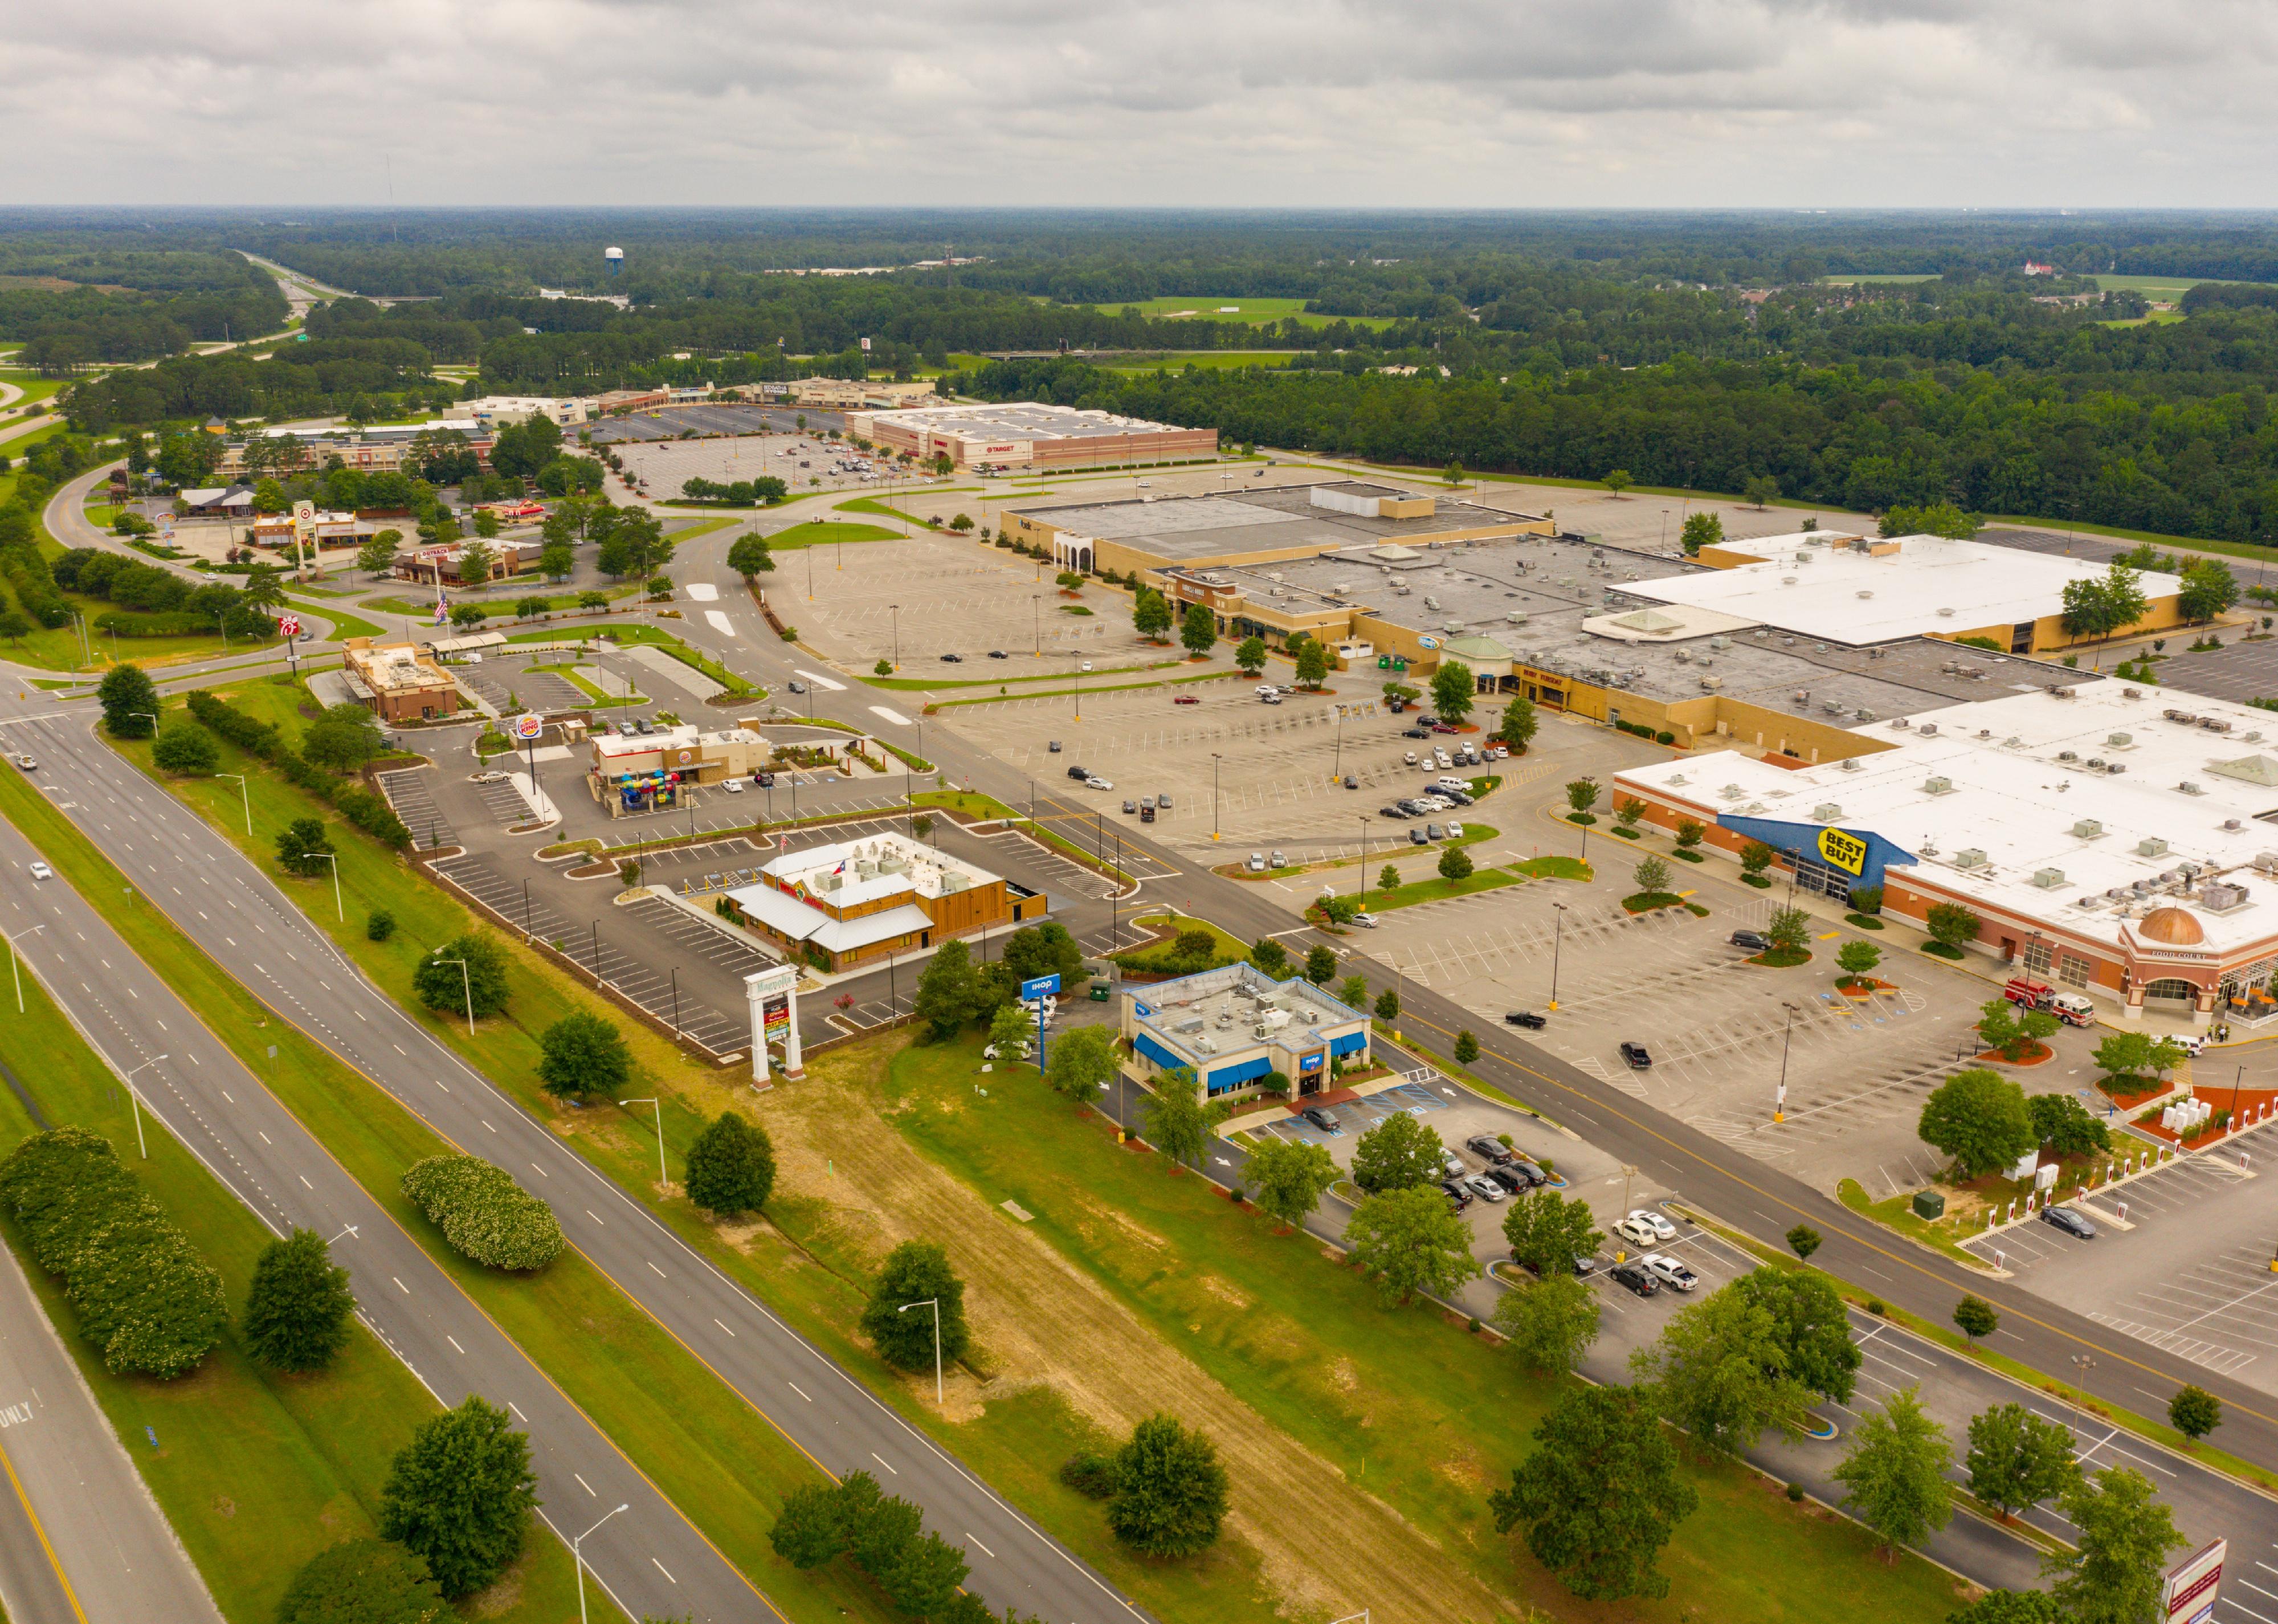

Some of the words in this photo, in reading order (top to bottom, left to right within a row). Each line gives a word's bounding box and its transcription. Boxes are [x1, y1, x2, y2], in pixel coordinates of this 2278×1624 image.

[1540, 674, 1563, 685] TUESDAY
[520, 719, 538, 729] BURGER
[521, 723, 538, 733] KING
[1826, 831, 1863, 856] BEST
[1826, 844, 1858, 867] BUY
[2152, 950, 2175, 958] FOOD
[2178, 952, 2207, 961] COURT
[757, 975, 792, 993] Magnolia
